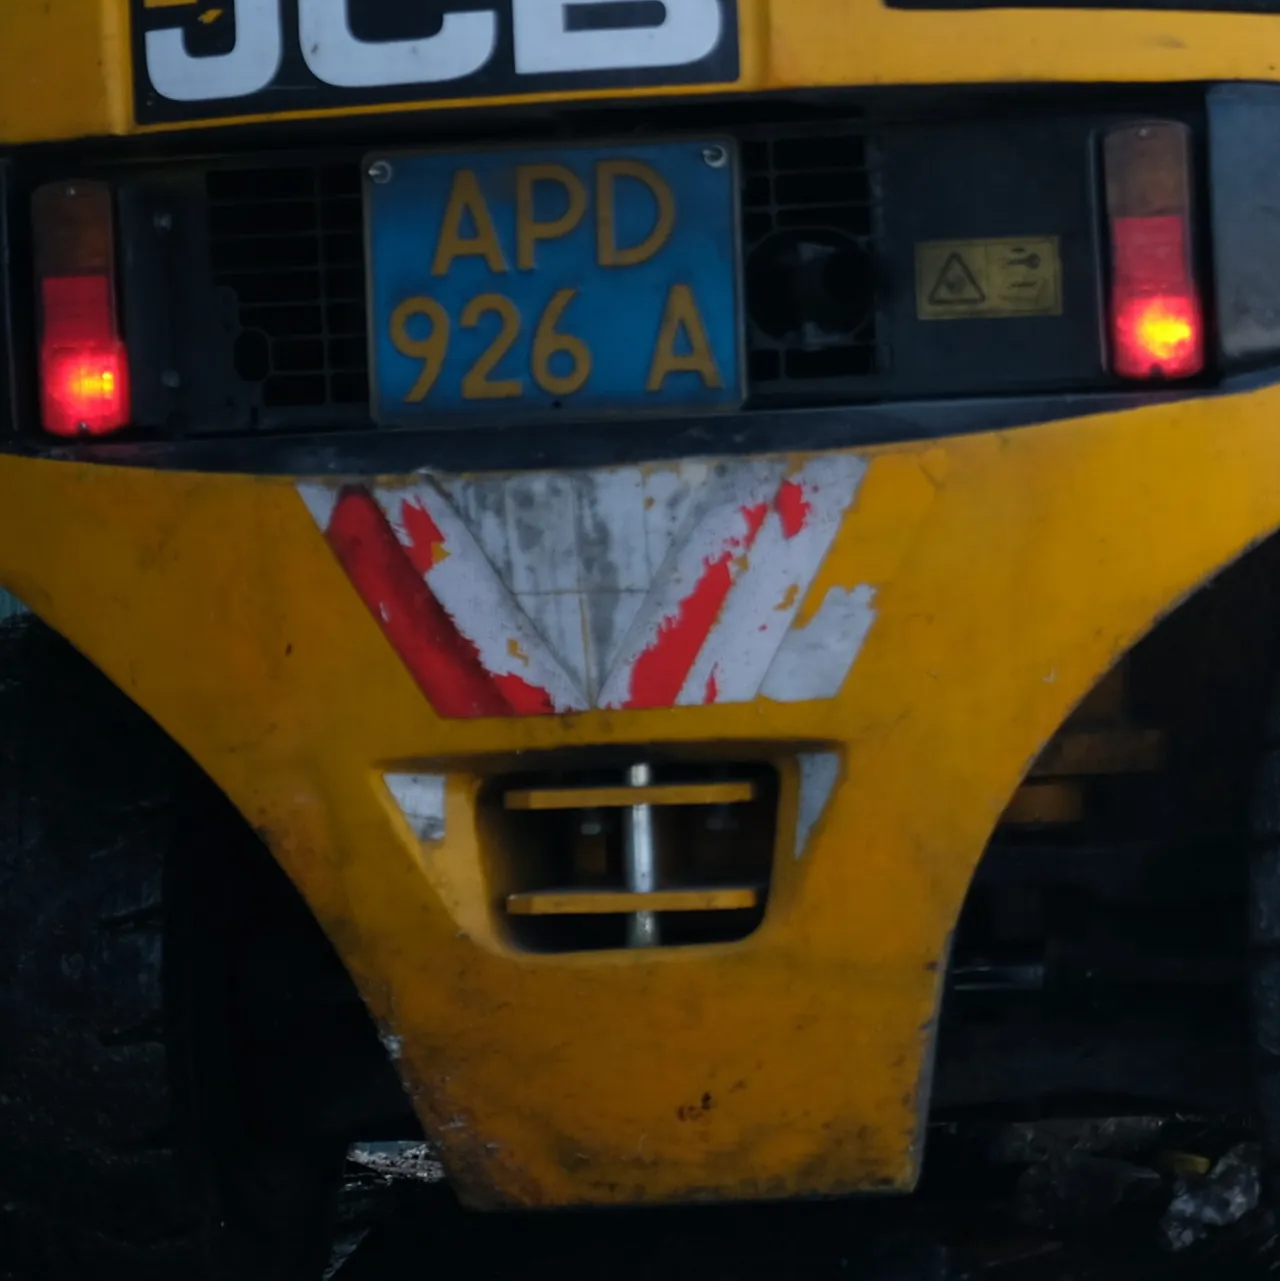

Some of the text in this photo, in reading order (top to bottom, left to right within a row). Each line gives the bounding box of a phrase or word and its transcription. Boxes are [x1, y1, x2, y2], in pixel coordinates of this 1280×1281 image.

[431, 159, 676, 277] APD
[389, 283, 724, 402] 926 A
